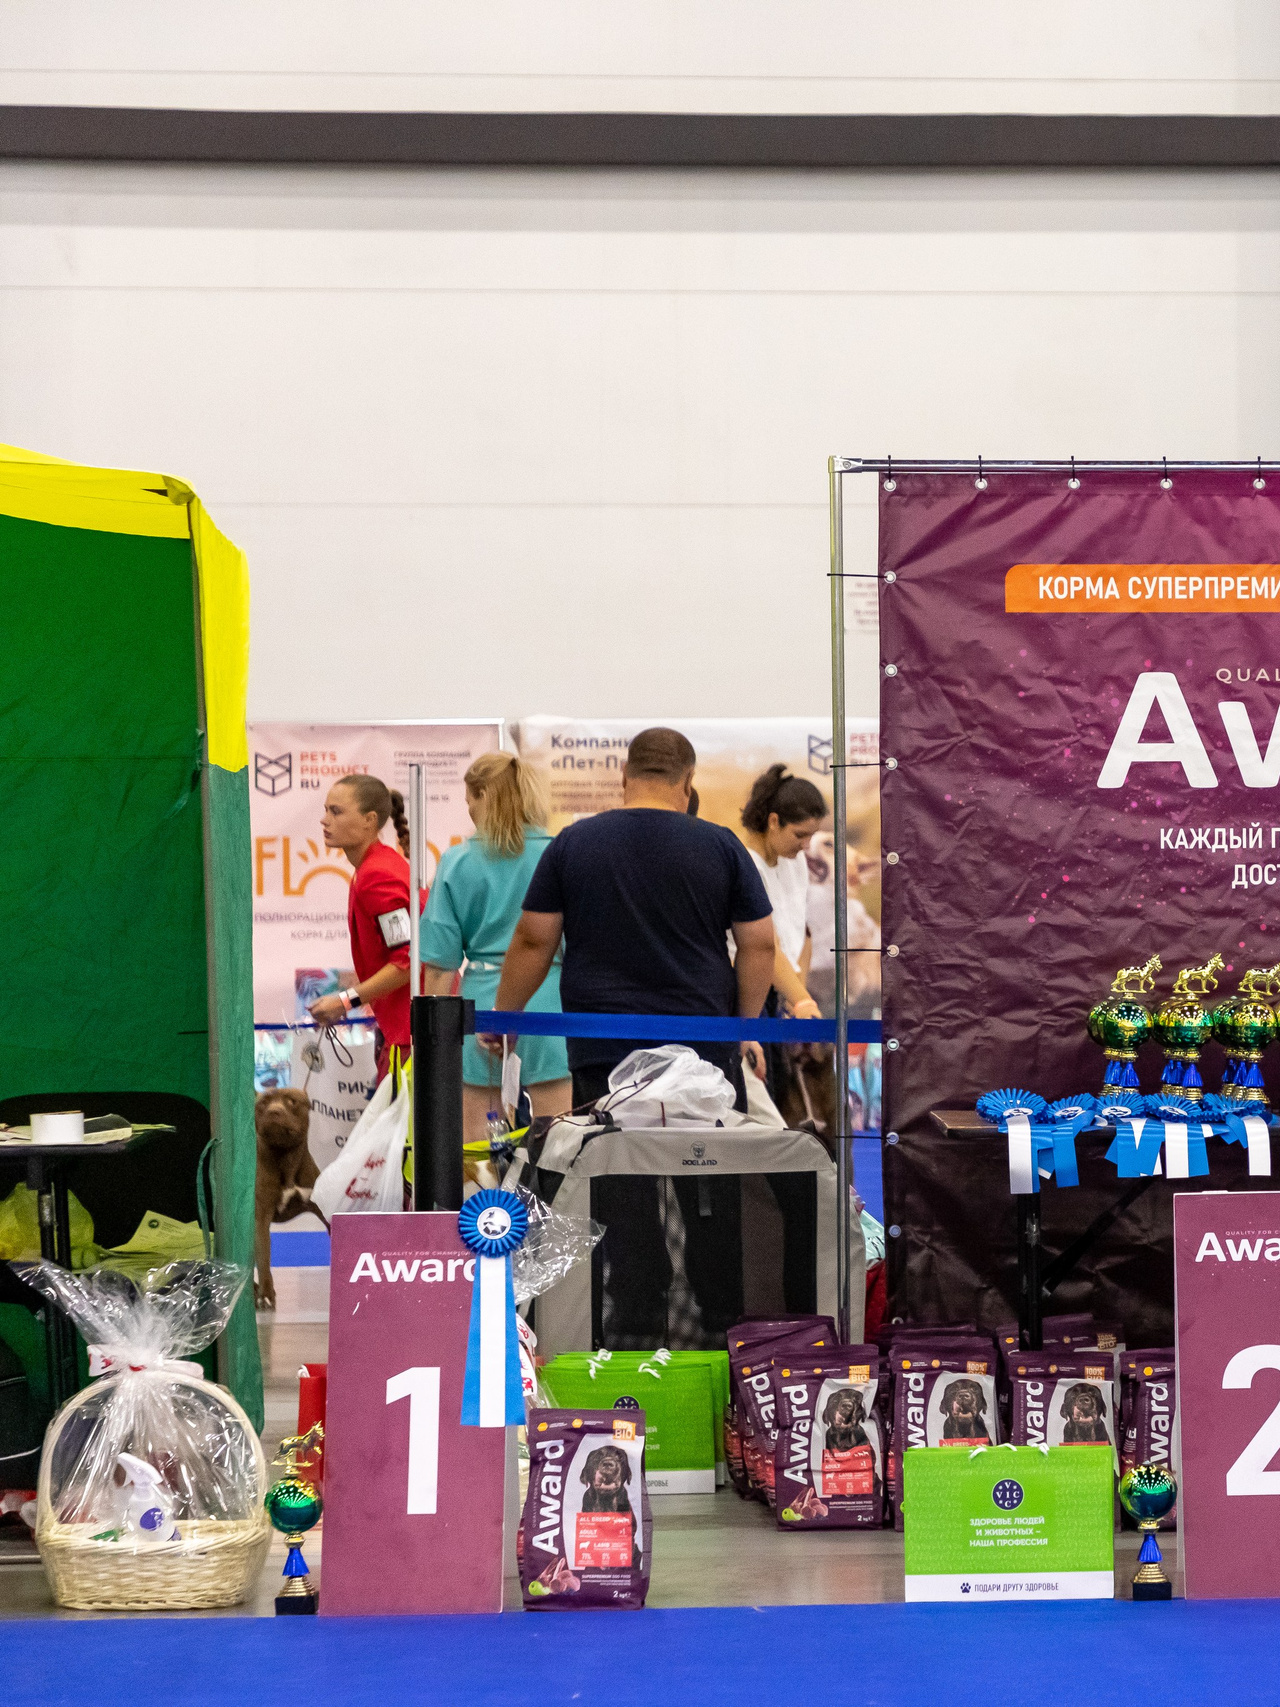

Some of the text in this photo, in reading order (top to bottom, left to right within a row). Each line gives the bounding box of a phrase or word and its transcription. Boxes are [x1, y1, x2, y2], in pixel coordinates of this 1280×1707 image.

[1038, 575, 1121, 600] КОРМА
[551, 735, 632, 748] Компани
[300, 751, 337, 761] PETS
[300, 779, 320, 788] RU
[1159, 822, 1263, 852] КАЖДЫЙ
[254, 911, 348, 922] ПОЛНОРАЦИОН
[337, 1080, 368, 1094] РИН
[311, 1099, 363, 1122] ПЛАНЕТ
[968, 1363, 985, 1371] 100%
[1086, 1367, 1102, 1375] 100%
[903, 1372, 925, 1448] ward
[1018, 1380, 1044, 1446] ward
[1146, 1382, 1170, 1468] ward
[615, 1430, 633, 1439] BIO
[782, 1384, 810, 1485] Award
[386, 1366, 441, 1515] 1
[646, 1479, 669, 1488] ОРОВЬЕ
[532, 1440, 565, 1556] Award
[970, 1516, 1045, 1526] ЗДОРОВЬЕ ЛЮДЕЙ
[984, 1528, 1033, 1536] ЖИВОТНЫХ
[997, 1538, 1048, 1546] ПРОФЕССИЯ
[975, 1582, 1059, 1592] ПОДАРИ ДРУГУ ЗДОРОВЬЕ
[613, 1590, 618, 1598] 2
